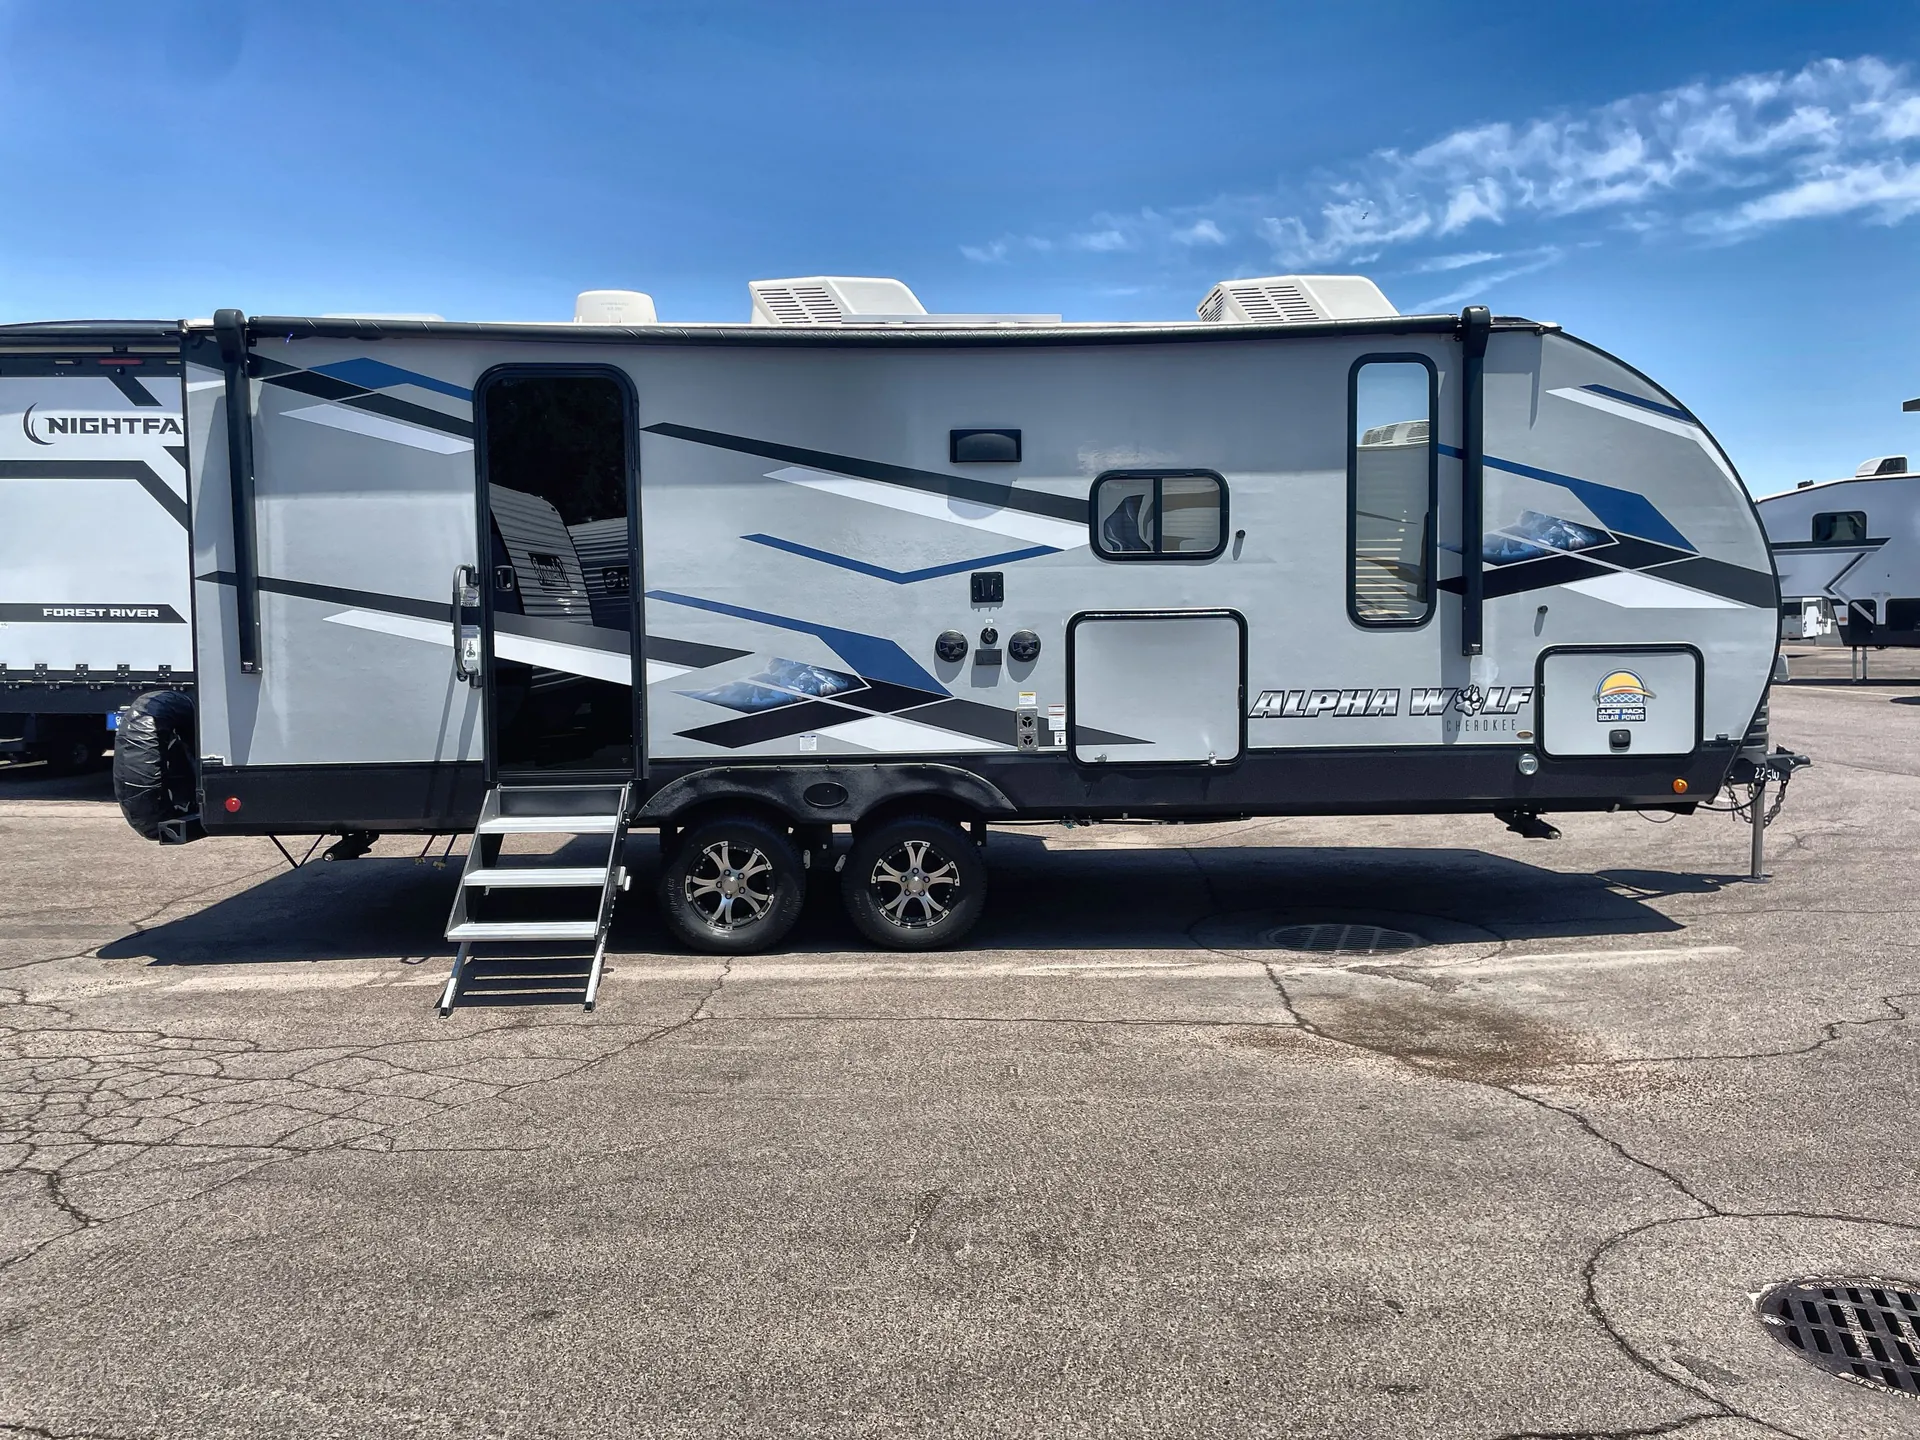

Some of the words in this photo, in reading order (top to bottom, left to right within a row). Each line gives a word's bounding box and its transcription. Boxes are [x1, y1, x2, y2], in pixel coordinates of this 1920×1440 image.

[44, 417, 184, 435] NIGHTFA
[42, 608, 107, 618] FOREST
[109, 608, 159, 618] RIVER
[1247, 689, 1400, 718] ALPHA
[1446, 719, 1516, 732] CHEROKEE
